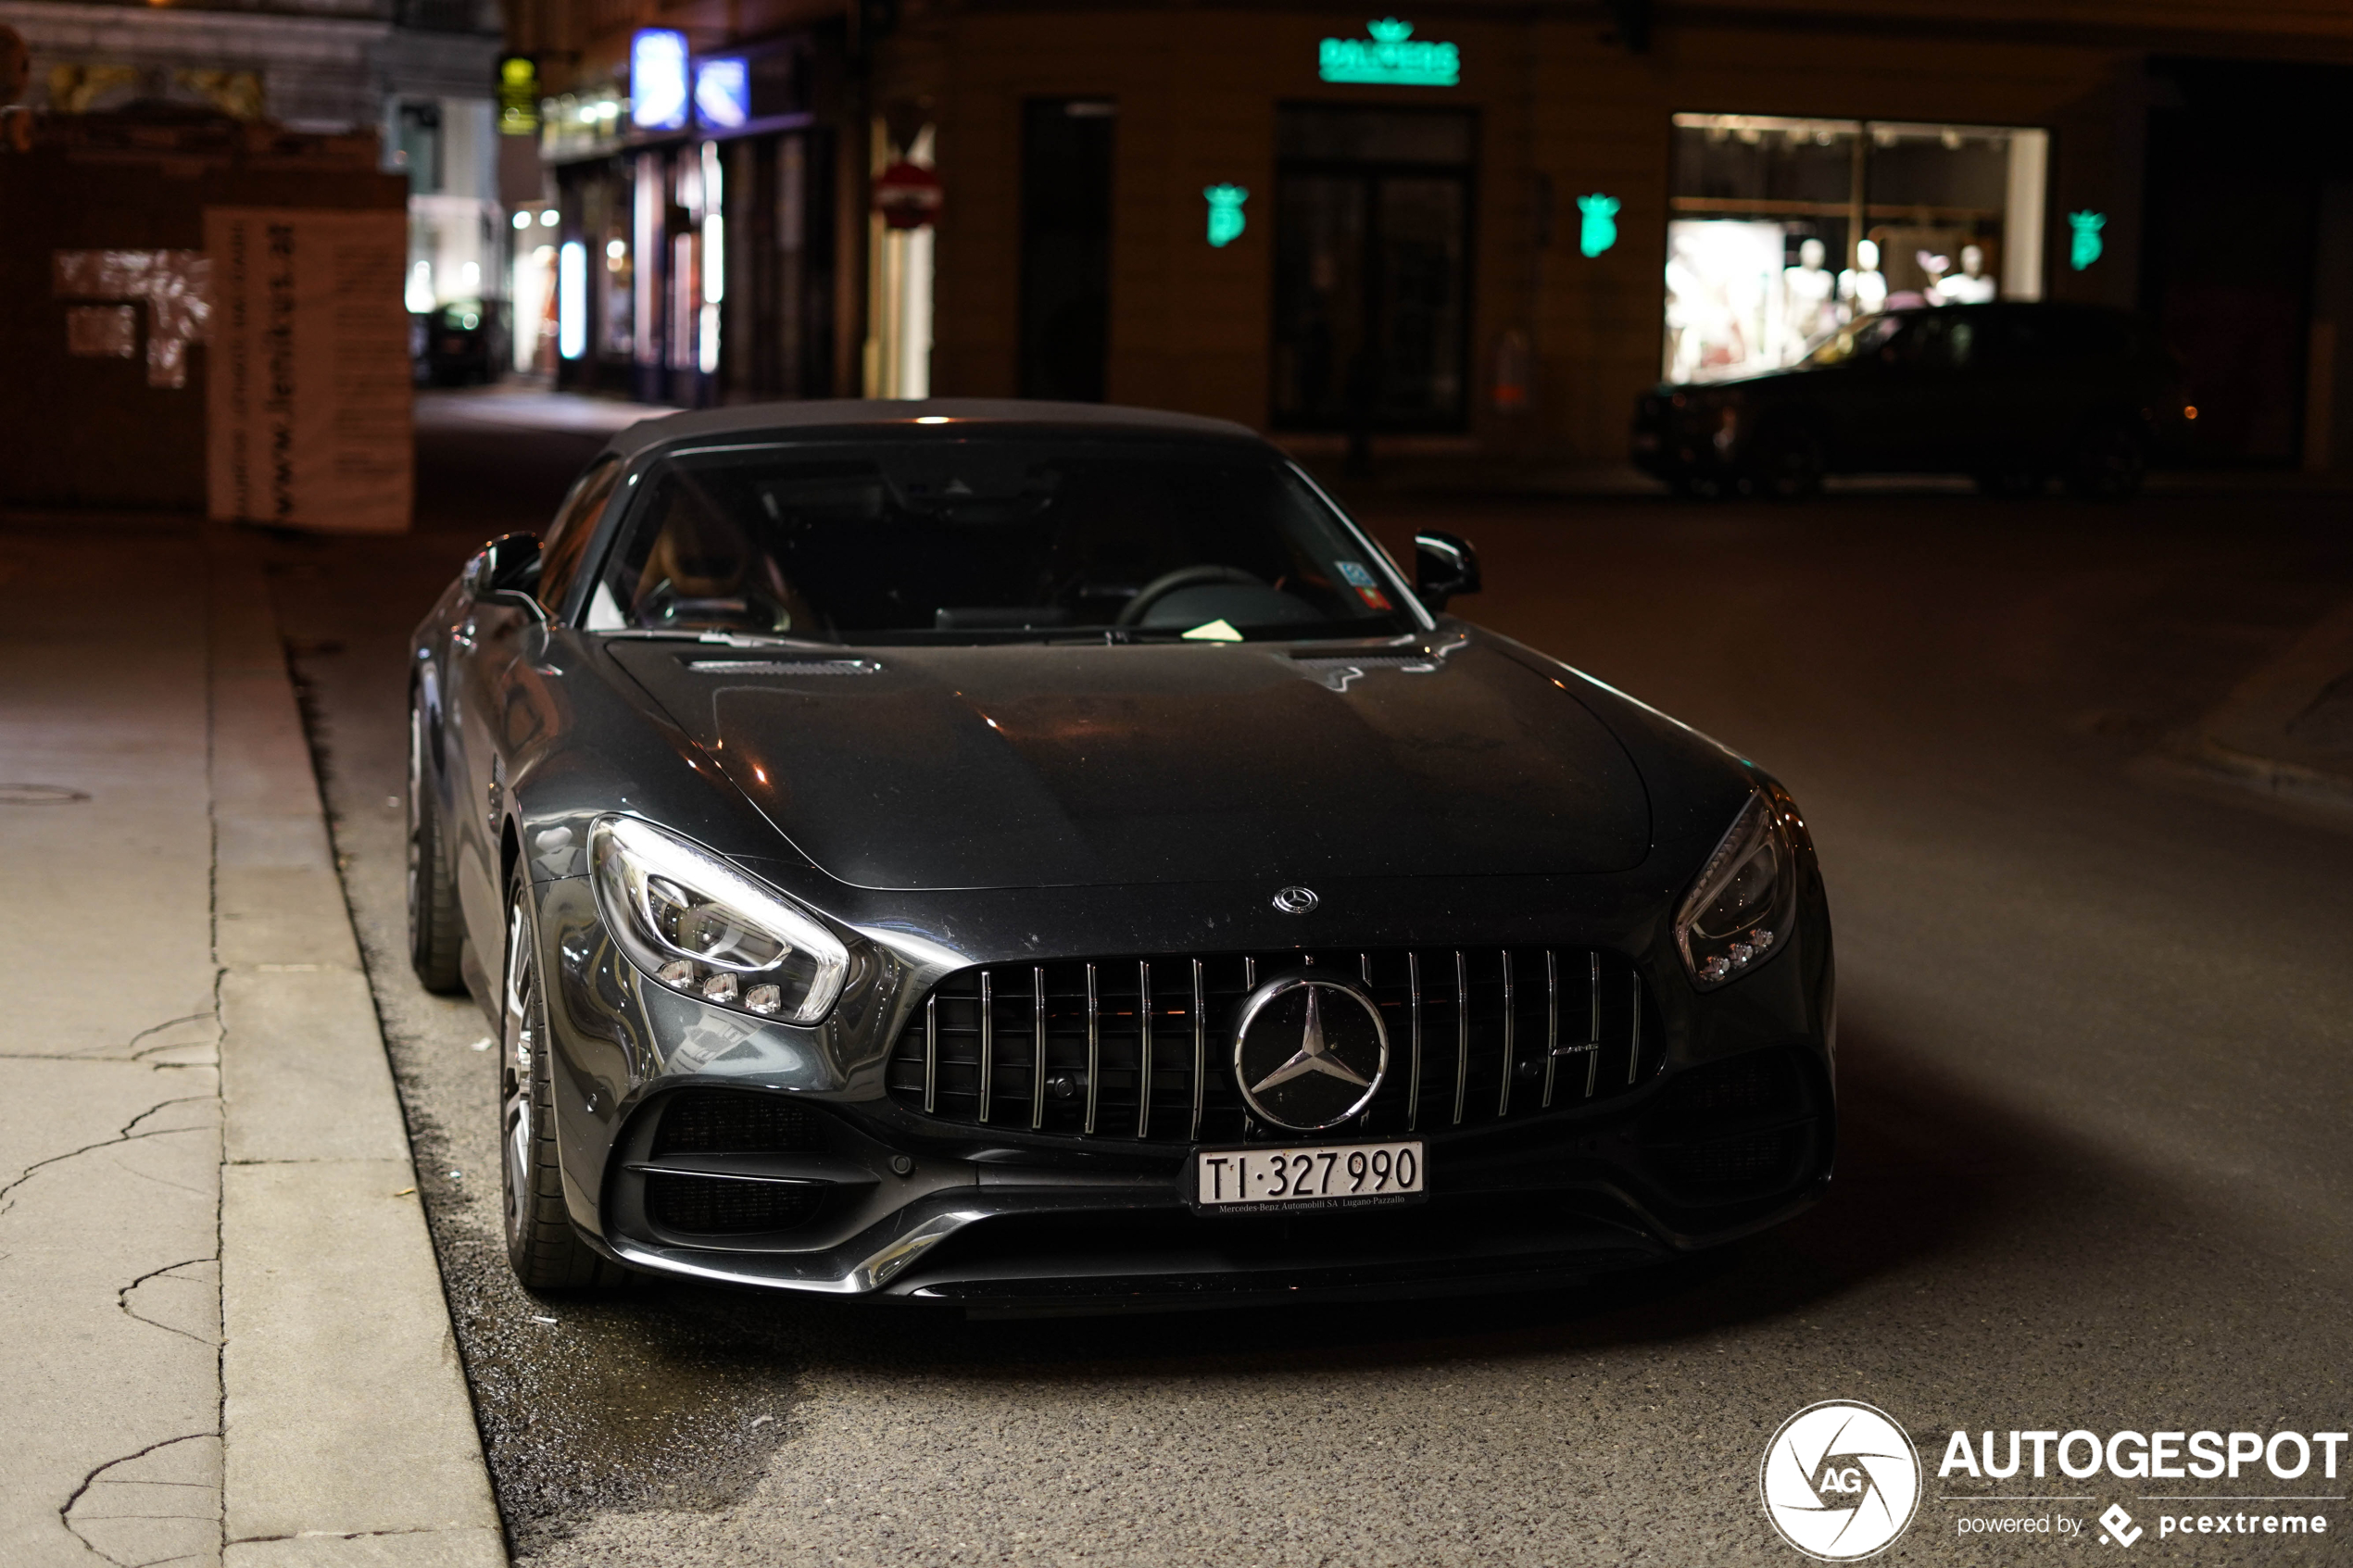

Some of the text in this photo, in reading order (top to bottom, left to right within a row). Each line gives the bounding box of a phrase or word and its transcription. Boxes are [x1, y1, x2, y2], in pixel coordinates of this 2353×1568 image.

[1219, 1196, 1405, 1213] Mercedes-Benz Automobili SA Lugano-Pazzallo
